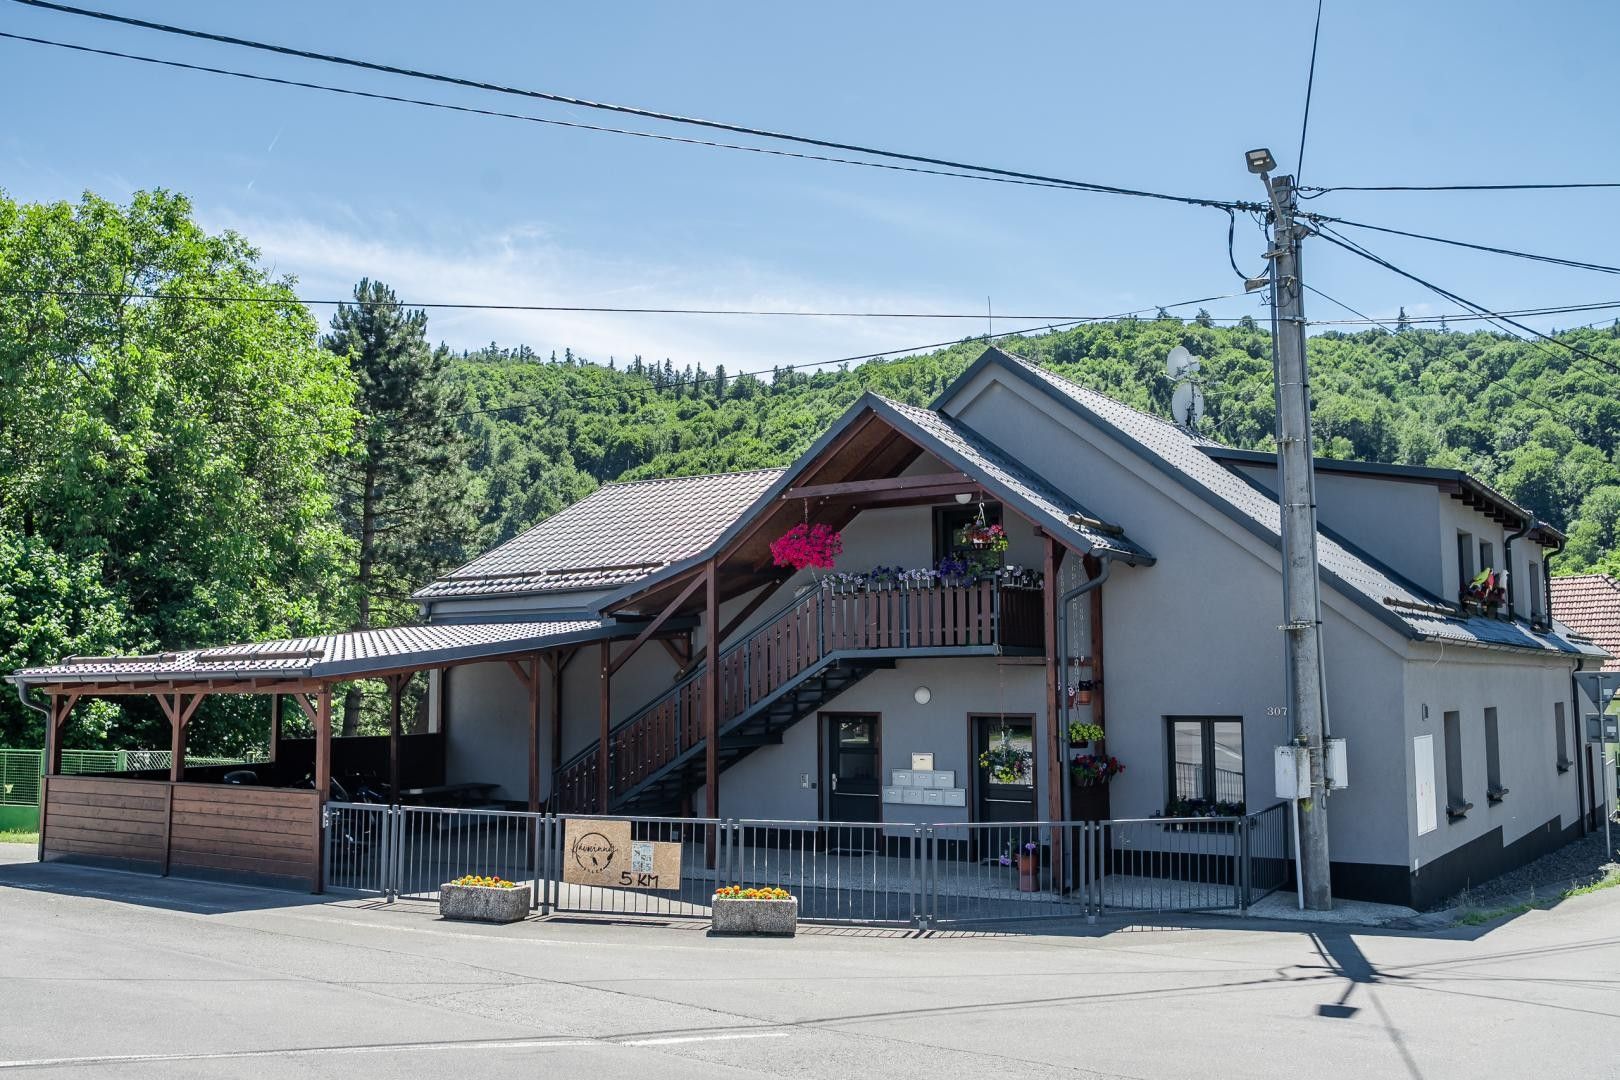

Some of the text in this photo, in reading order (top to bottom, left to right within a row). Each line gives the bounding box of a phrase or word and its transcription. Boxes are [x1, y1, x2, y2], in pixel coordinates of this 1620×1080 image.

[1267, 706, 1288, 716] 307
[619, 871, 659, 889] 5 KM
